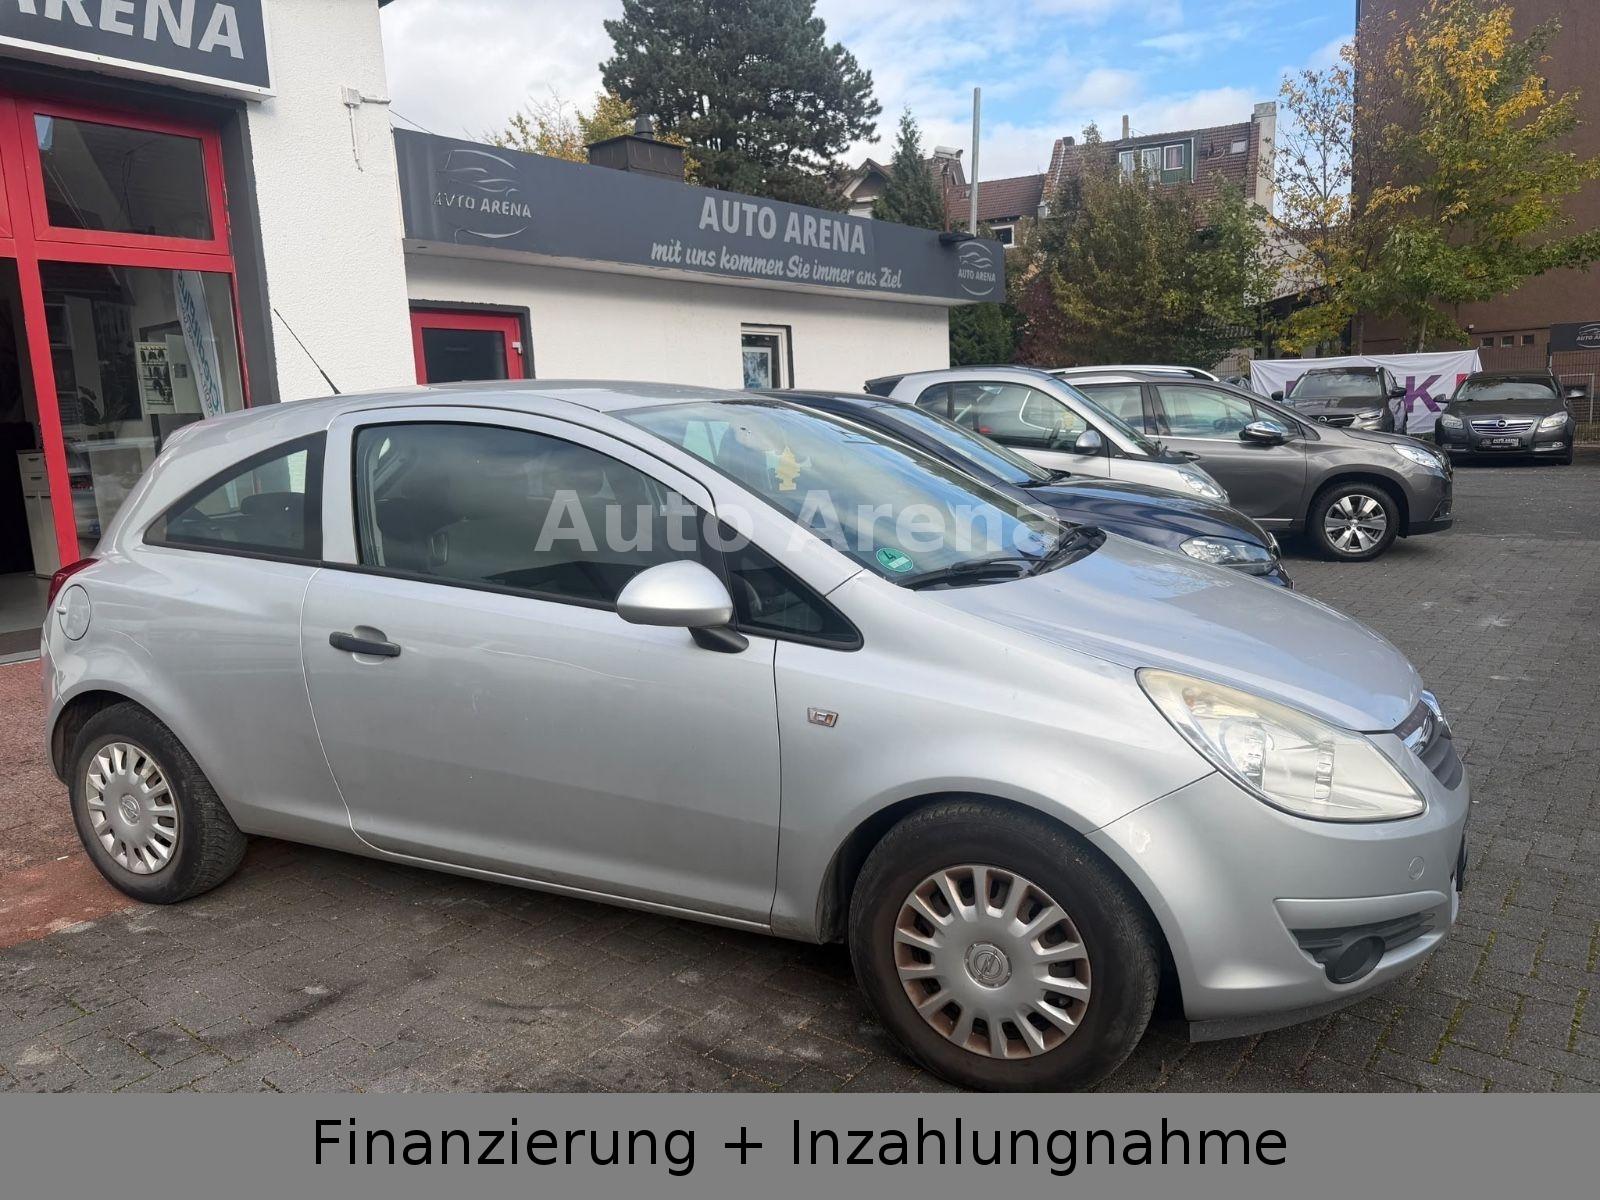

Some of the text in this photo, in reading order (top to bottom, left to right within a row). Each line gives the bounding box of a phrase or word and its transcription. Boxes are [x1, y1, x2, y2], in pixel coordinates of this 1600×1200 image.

[480, 198, 532, 218] ARENA
[699, 196, 866, 255] AUTO ARENA
[651, 240, 903, 289] mit uns kommen Sie immer ans Ziel
[958, 268, 996, 282] AUTO ARENA
